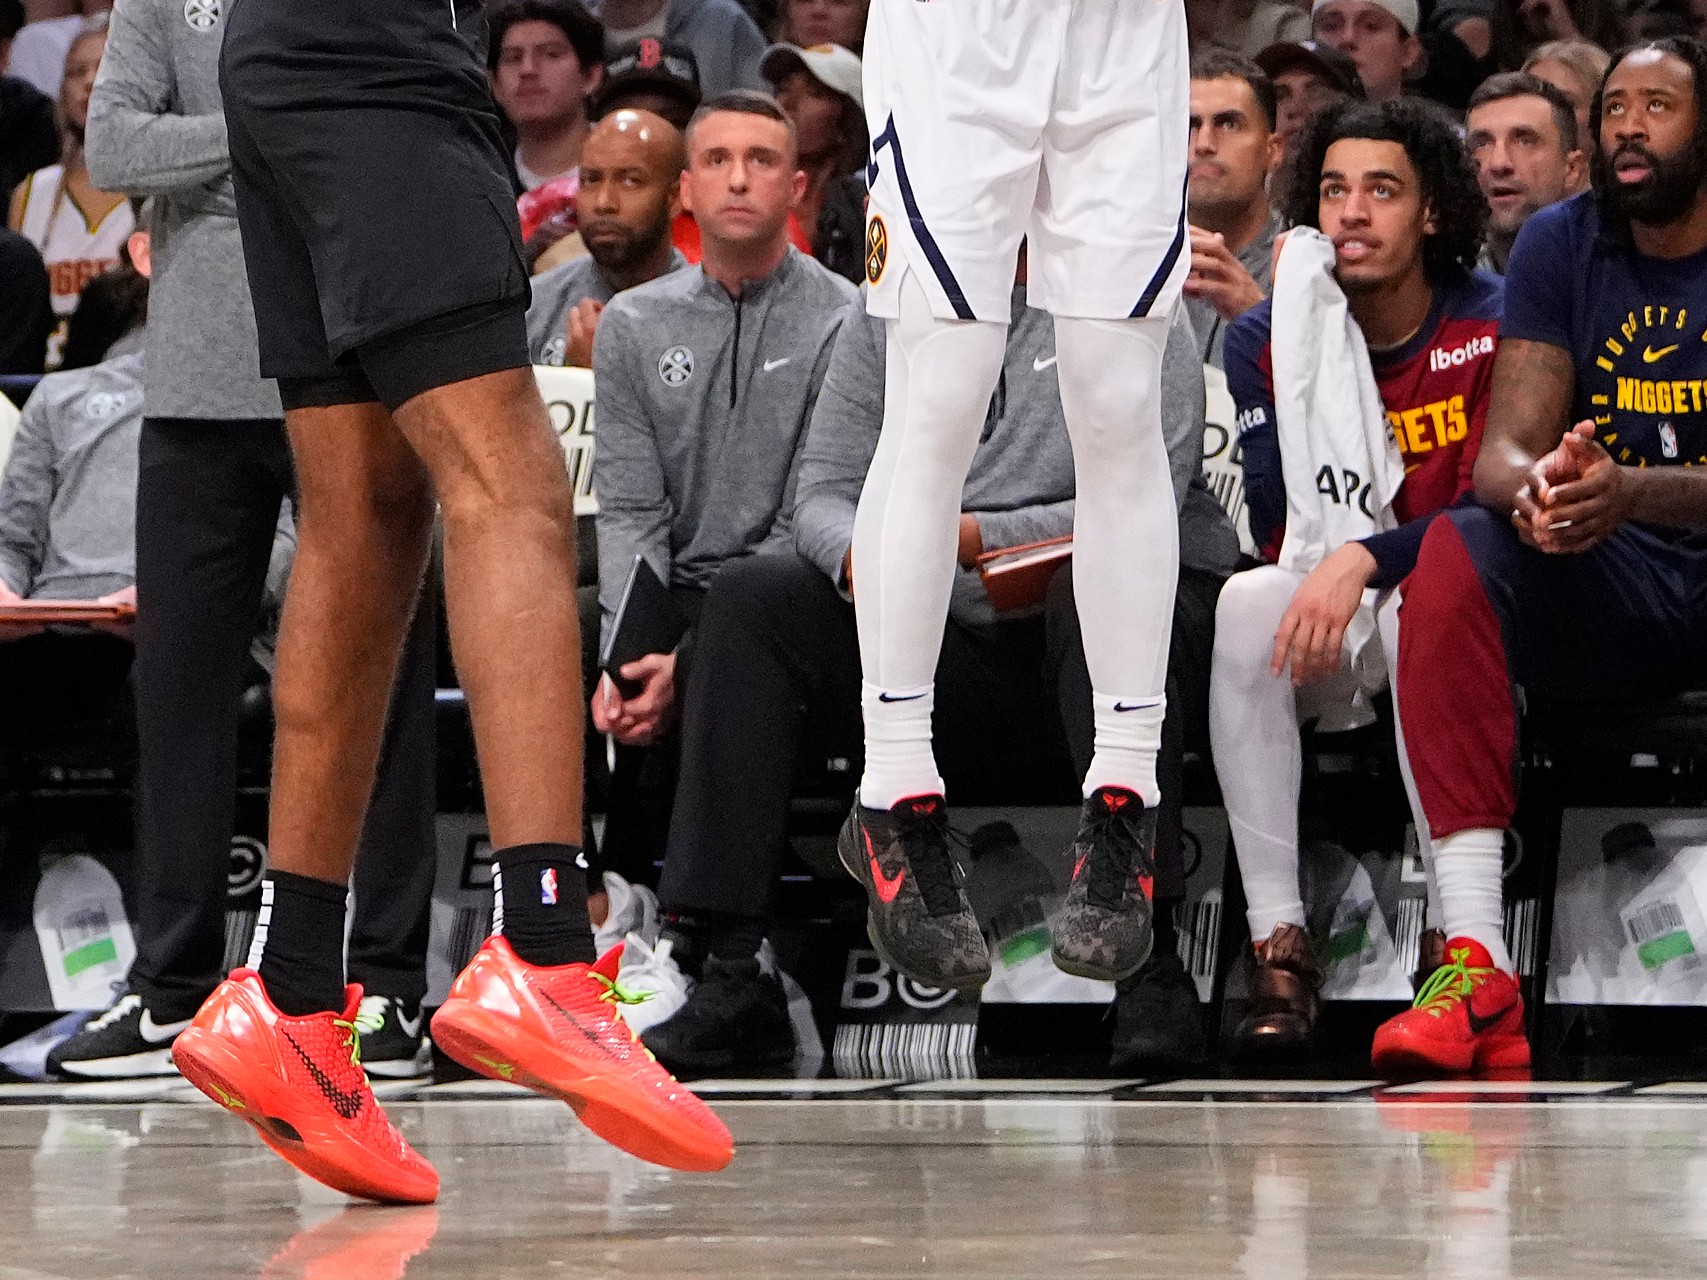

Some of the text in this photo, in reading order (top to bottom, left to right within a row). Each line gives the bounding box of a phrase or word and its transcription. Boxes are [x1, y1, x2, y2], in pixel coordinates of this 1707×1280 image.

[637, 37, 661, 68] B
[1430, 335, 1494, 372] ibotta
[1616, 376, 1707, 415] NUGGET
[1236, 406, 1266, 434] tta
